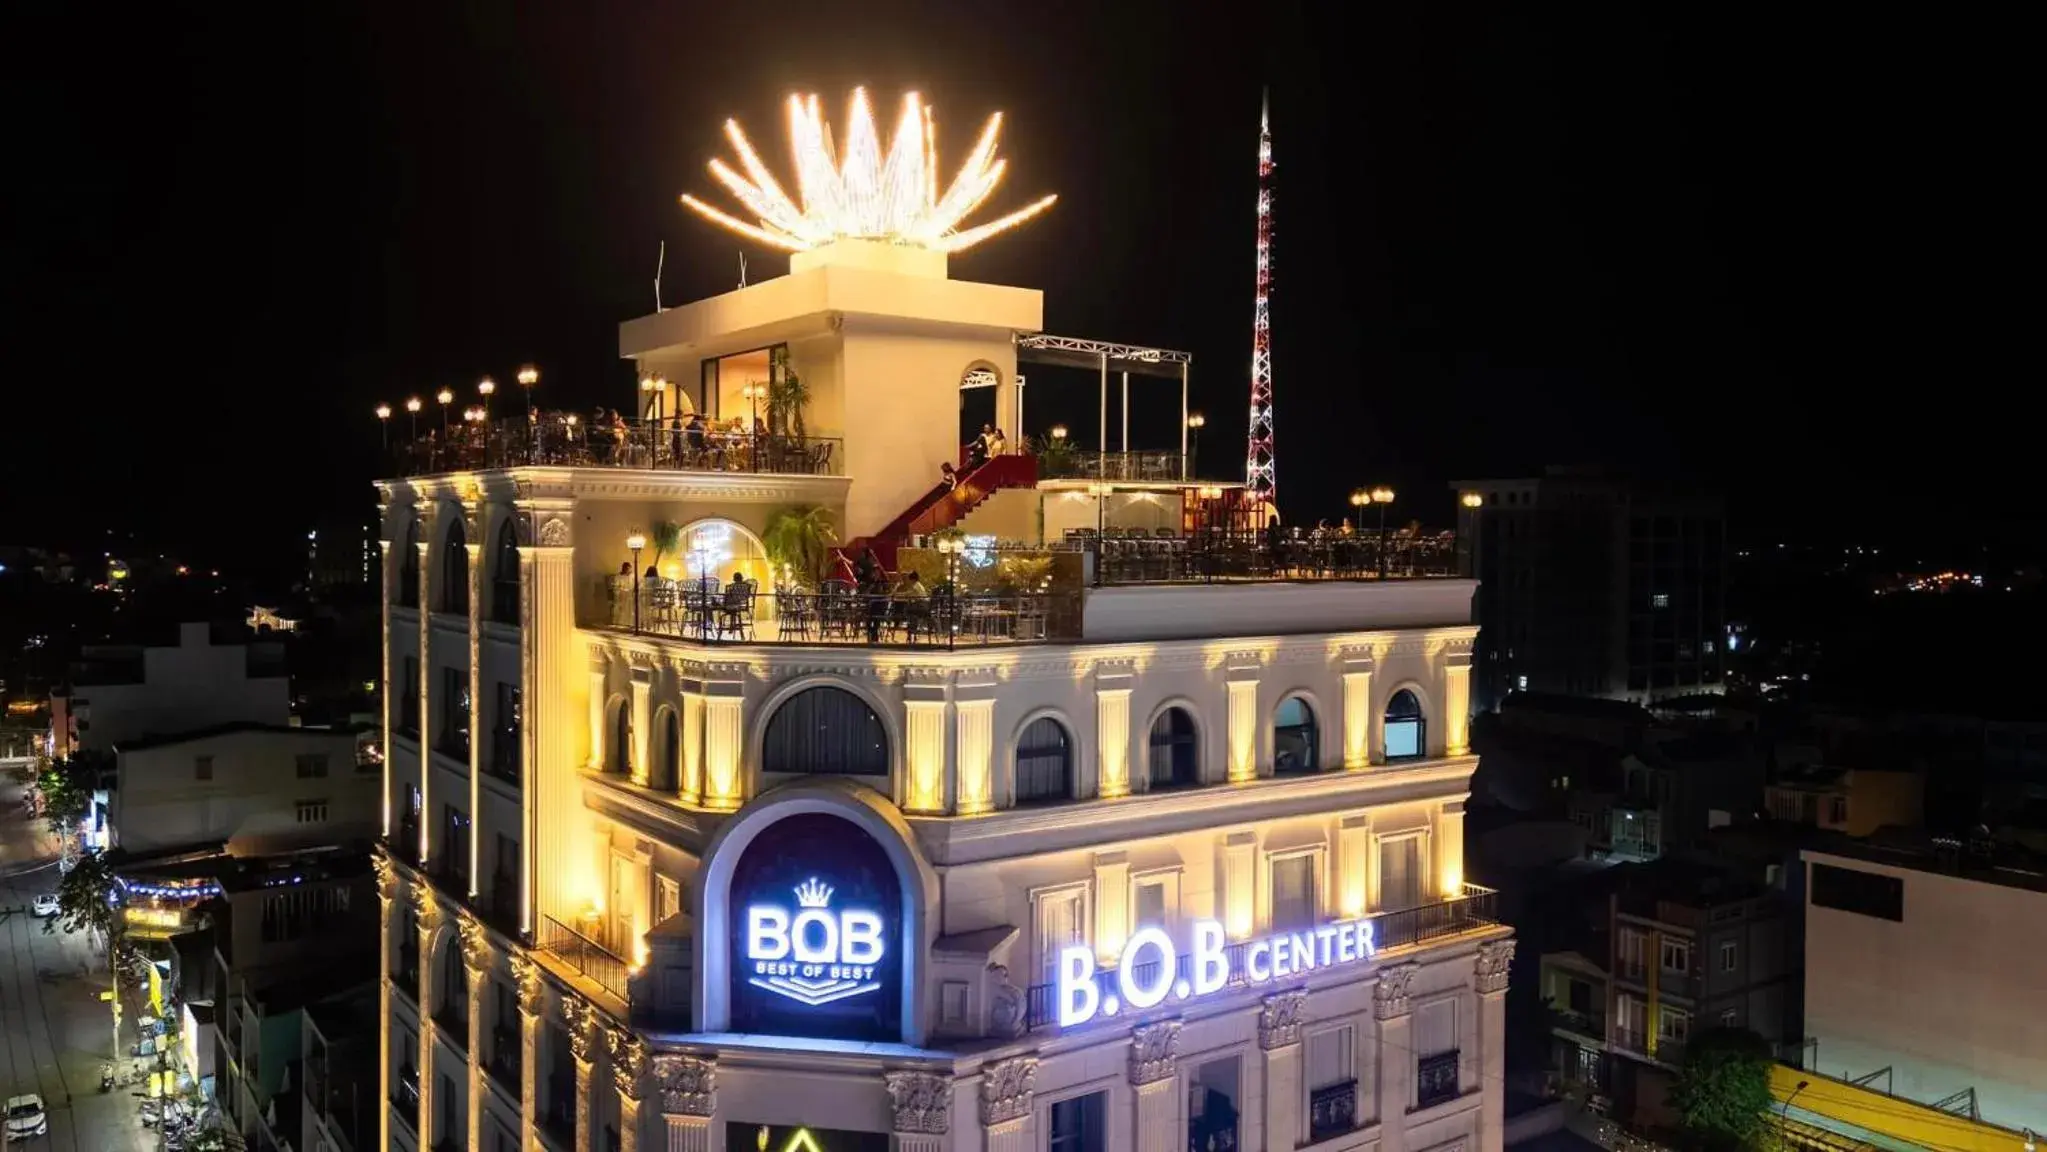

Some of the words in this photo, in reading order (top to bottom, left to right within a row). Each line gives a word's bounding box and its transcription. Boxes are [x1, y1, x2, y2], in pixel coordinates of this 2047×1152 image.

[748, 906, 884, 964] BOB
[756, 961, 798, 976] BEST
[802, 964, 825, 978] OF
[830, 966, 874, 980] BEST
[1058, 918, 1230, 1029] B.O.B
[1247, 920, 1376, 982] CENTER
